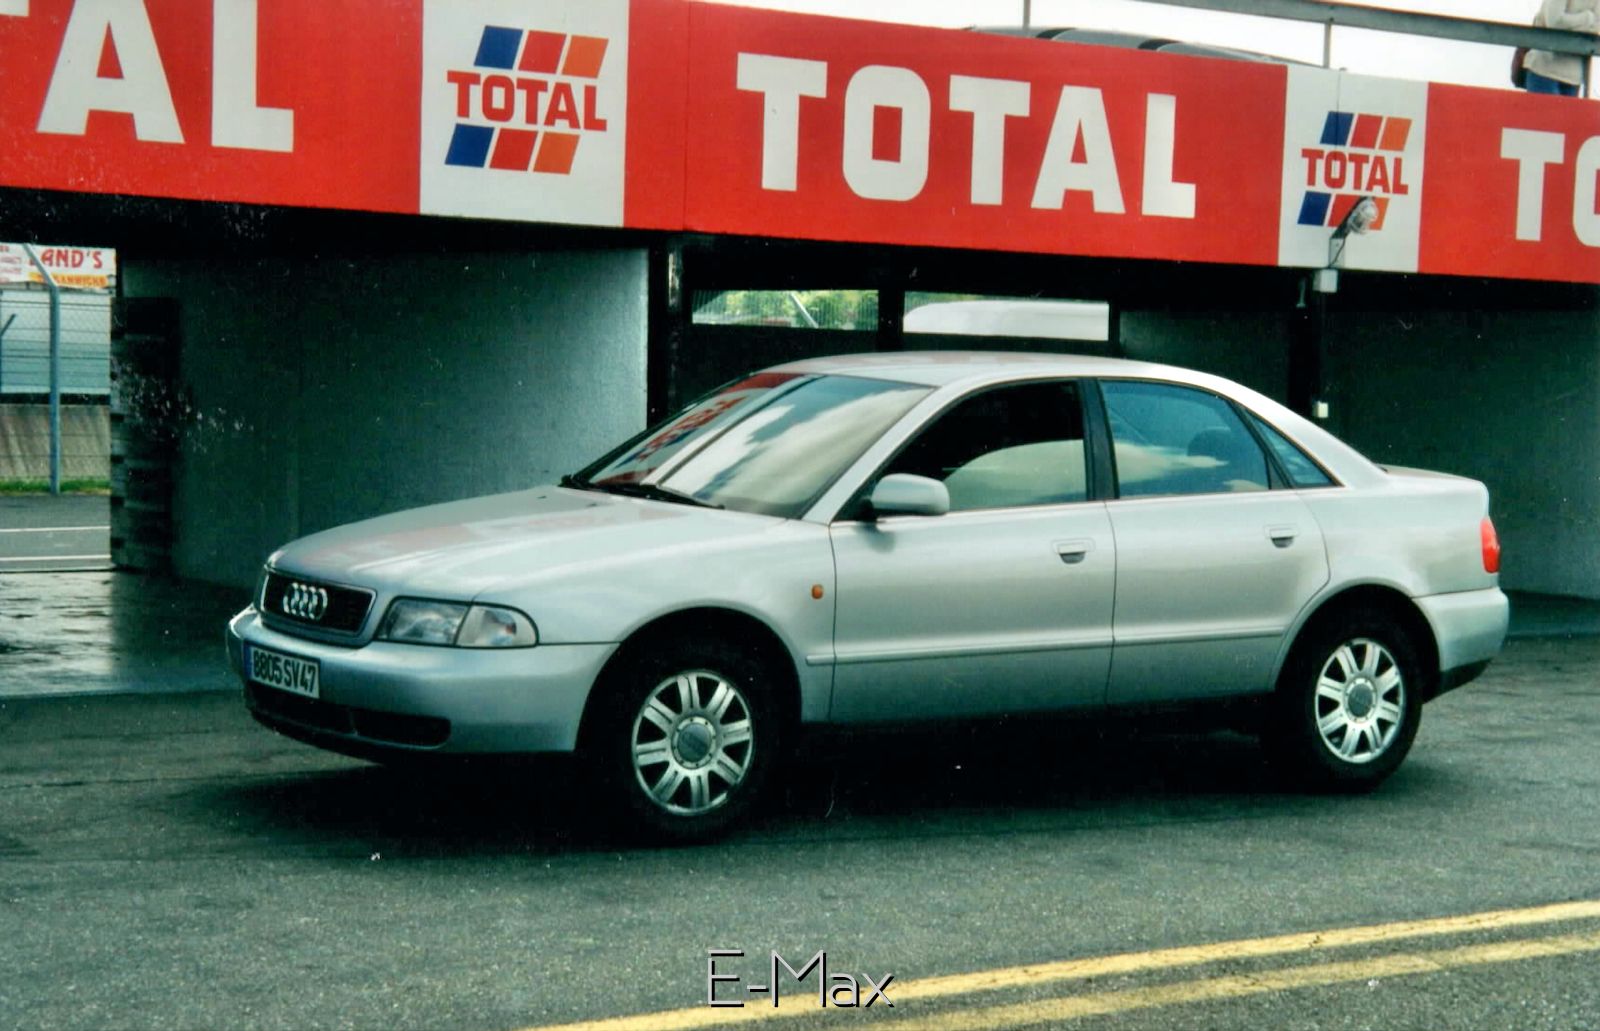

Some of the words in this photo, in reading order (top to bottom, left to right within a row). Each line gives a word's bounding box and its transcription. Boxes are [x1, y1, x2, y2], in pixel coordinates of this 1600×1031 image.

[0, 0, 294, 152] AL
[447, 70, 607, 132] TOTAL
[736, 52, 1196, 219] TOTAL
[1301, 148, 1409, 195] TOTAL
